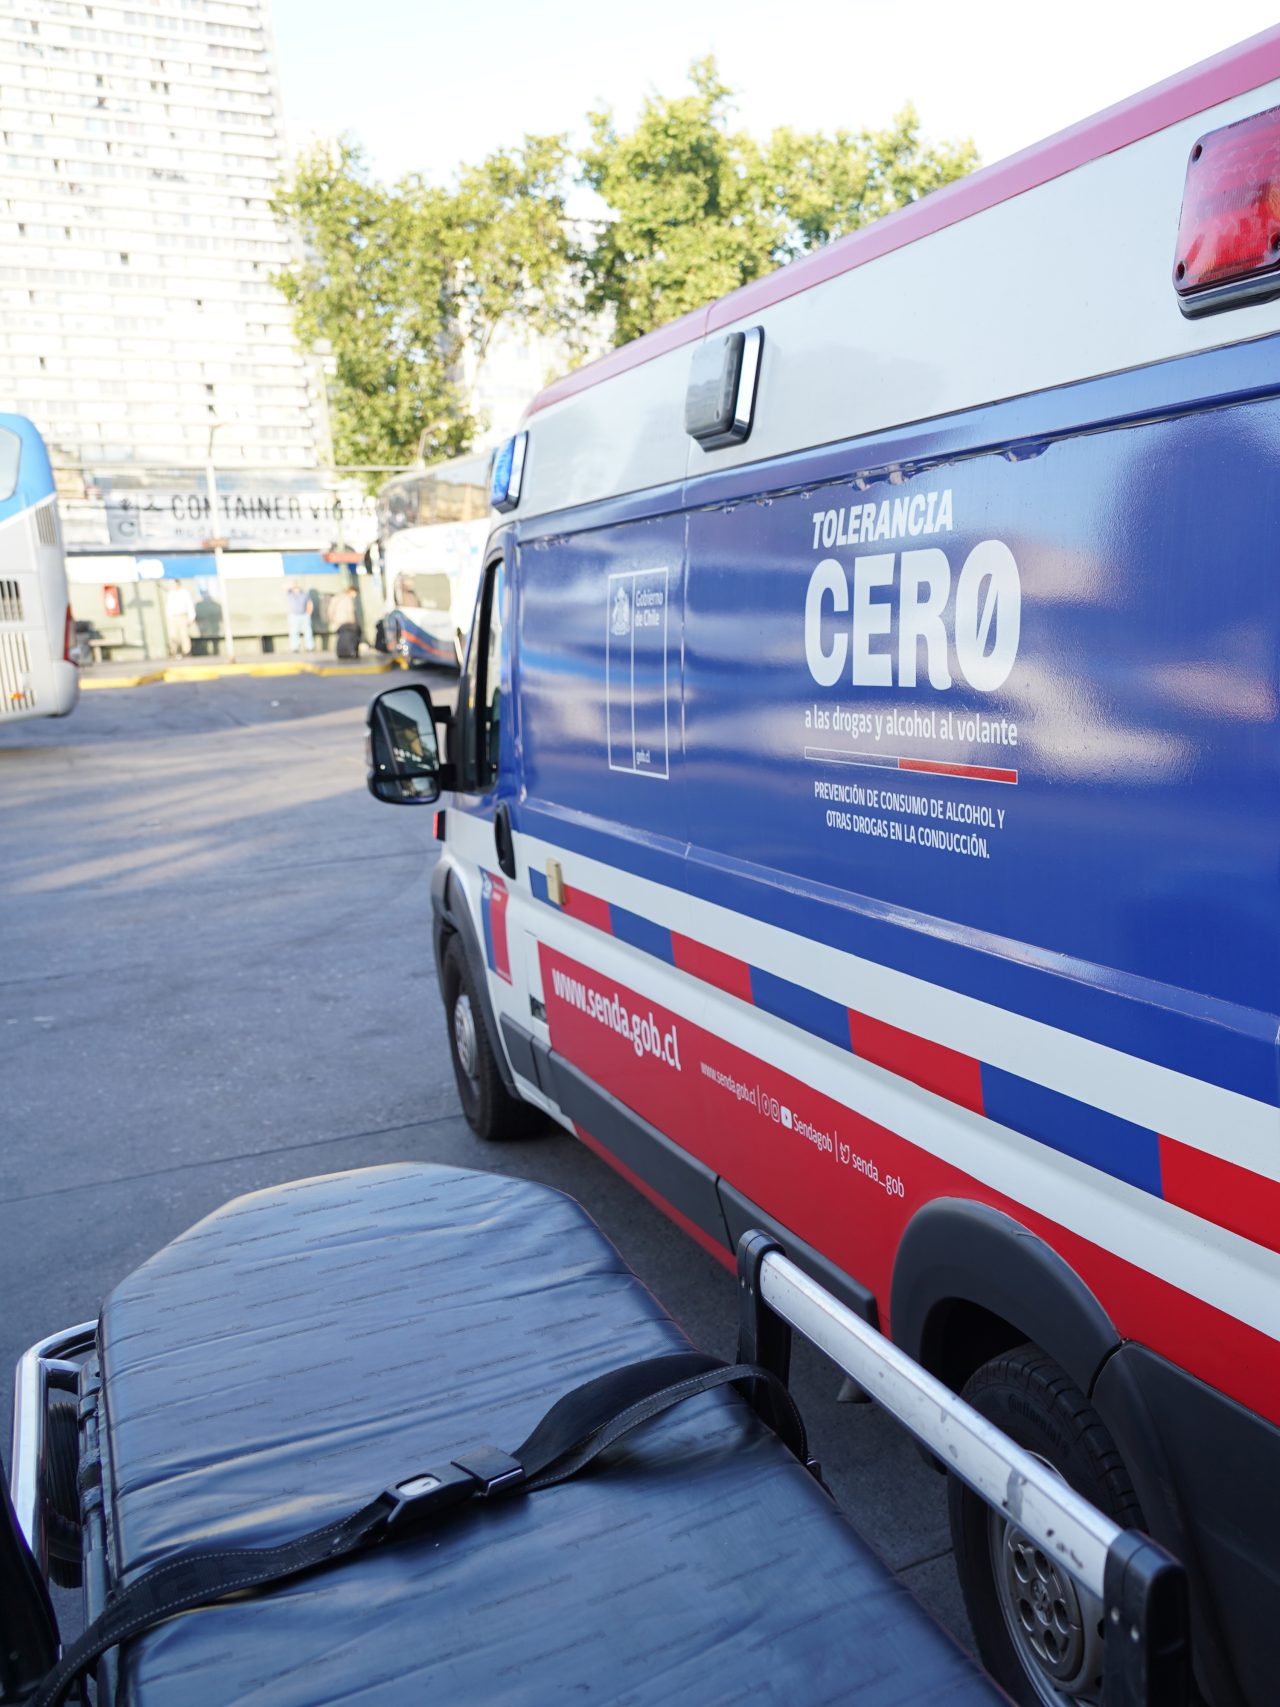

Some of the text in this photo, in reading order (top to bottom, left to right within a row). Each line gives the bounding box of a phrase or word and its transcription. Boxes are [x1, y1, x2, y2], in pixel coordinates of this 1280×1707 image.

[812, 488, 953, 549] TOLERANCIA
[635, 589, 664, 607] Gobierno
[635, 608, 660, 627] de Chile
[805, 704, 1018, 746] a las drogas y alcohol al volante
[814, 781, 1005, 830] PREVENCIÓN DE CONSUMO DE ALCOHOL Y
[826, 810, 990, 860] OTRAS DROGAS EN LA CONDUCCIÓN.
[551, 968, 682, 1072] www.senda.gob.cl
[700, 1061, 905, 1198] www.senda.gob.cl Sendagob senda_gob
